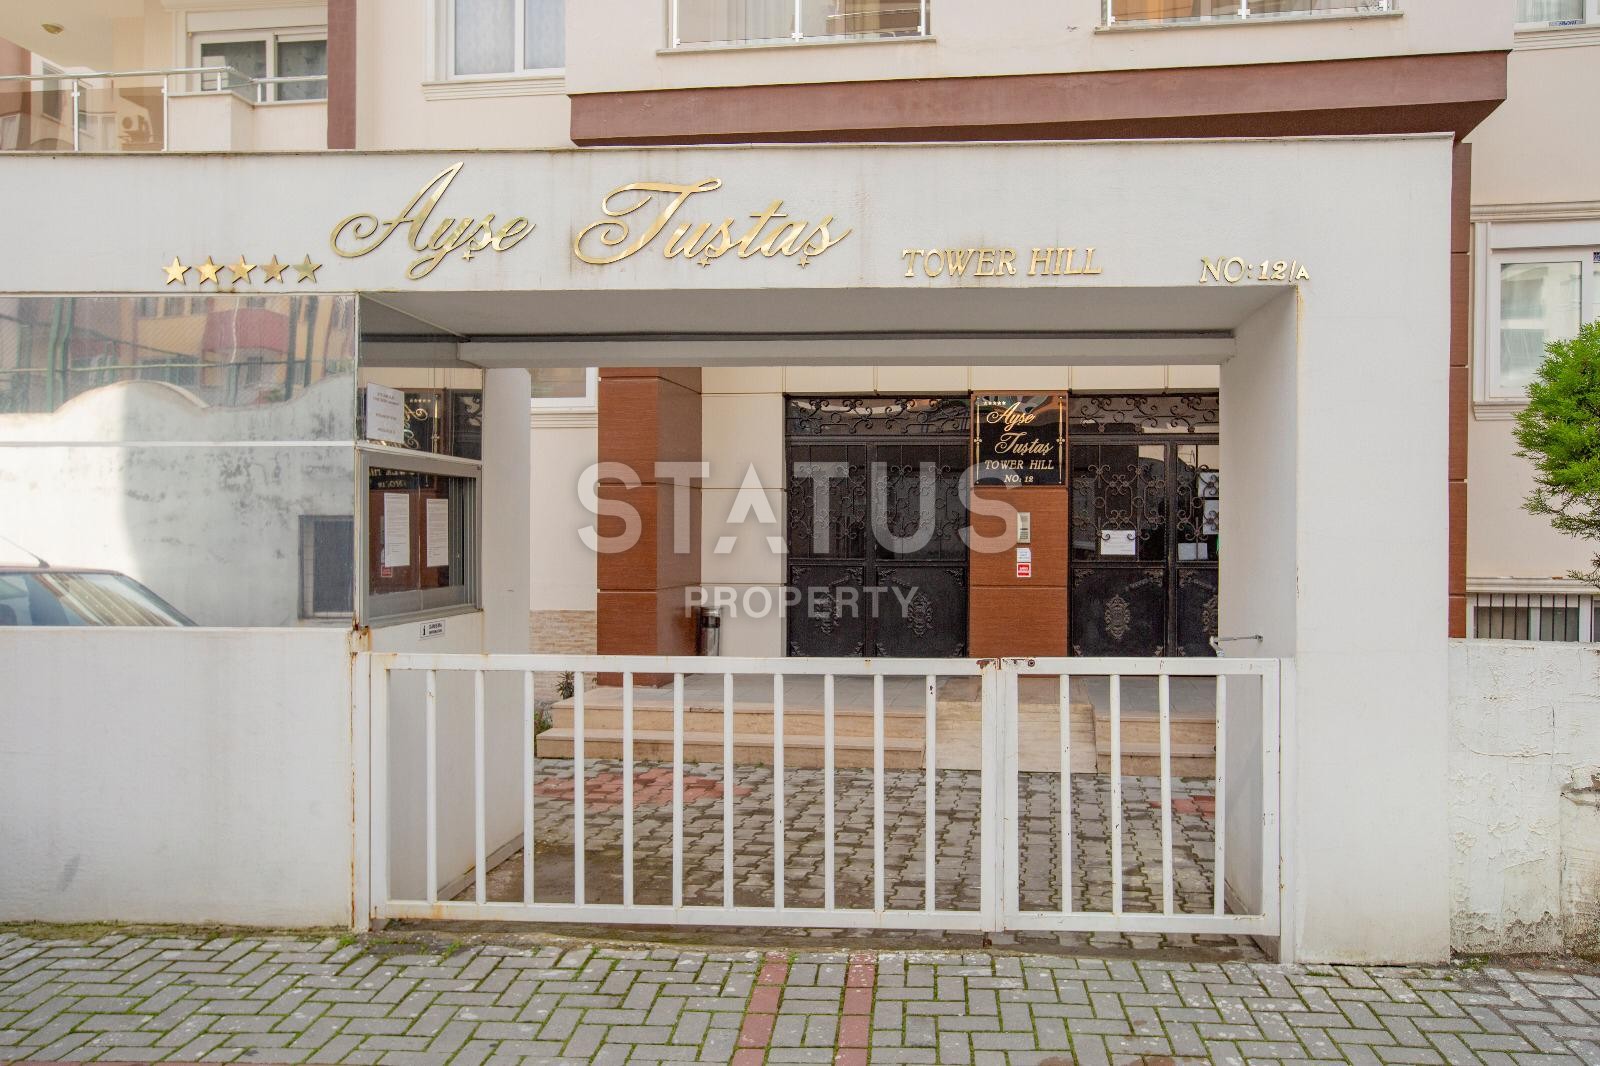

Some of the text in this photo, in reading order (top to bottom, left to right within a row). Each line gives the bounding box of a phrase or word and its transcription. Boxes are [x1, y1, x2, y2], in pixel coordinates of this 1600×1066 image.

[330, 161, 852, 280] Ayşe Tuştaş
[902, 247, 1102, 277] TOWER HILL
[985, 460, 1054, 470] TOWER HILL
